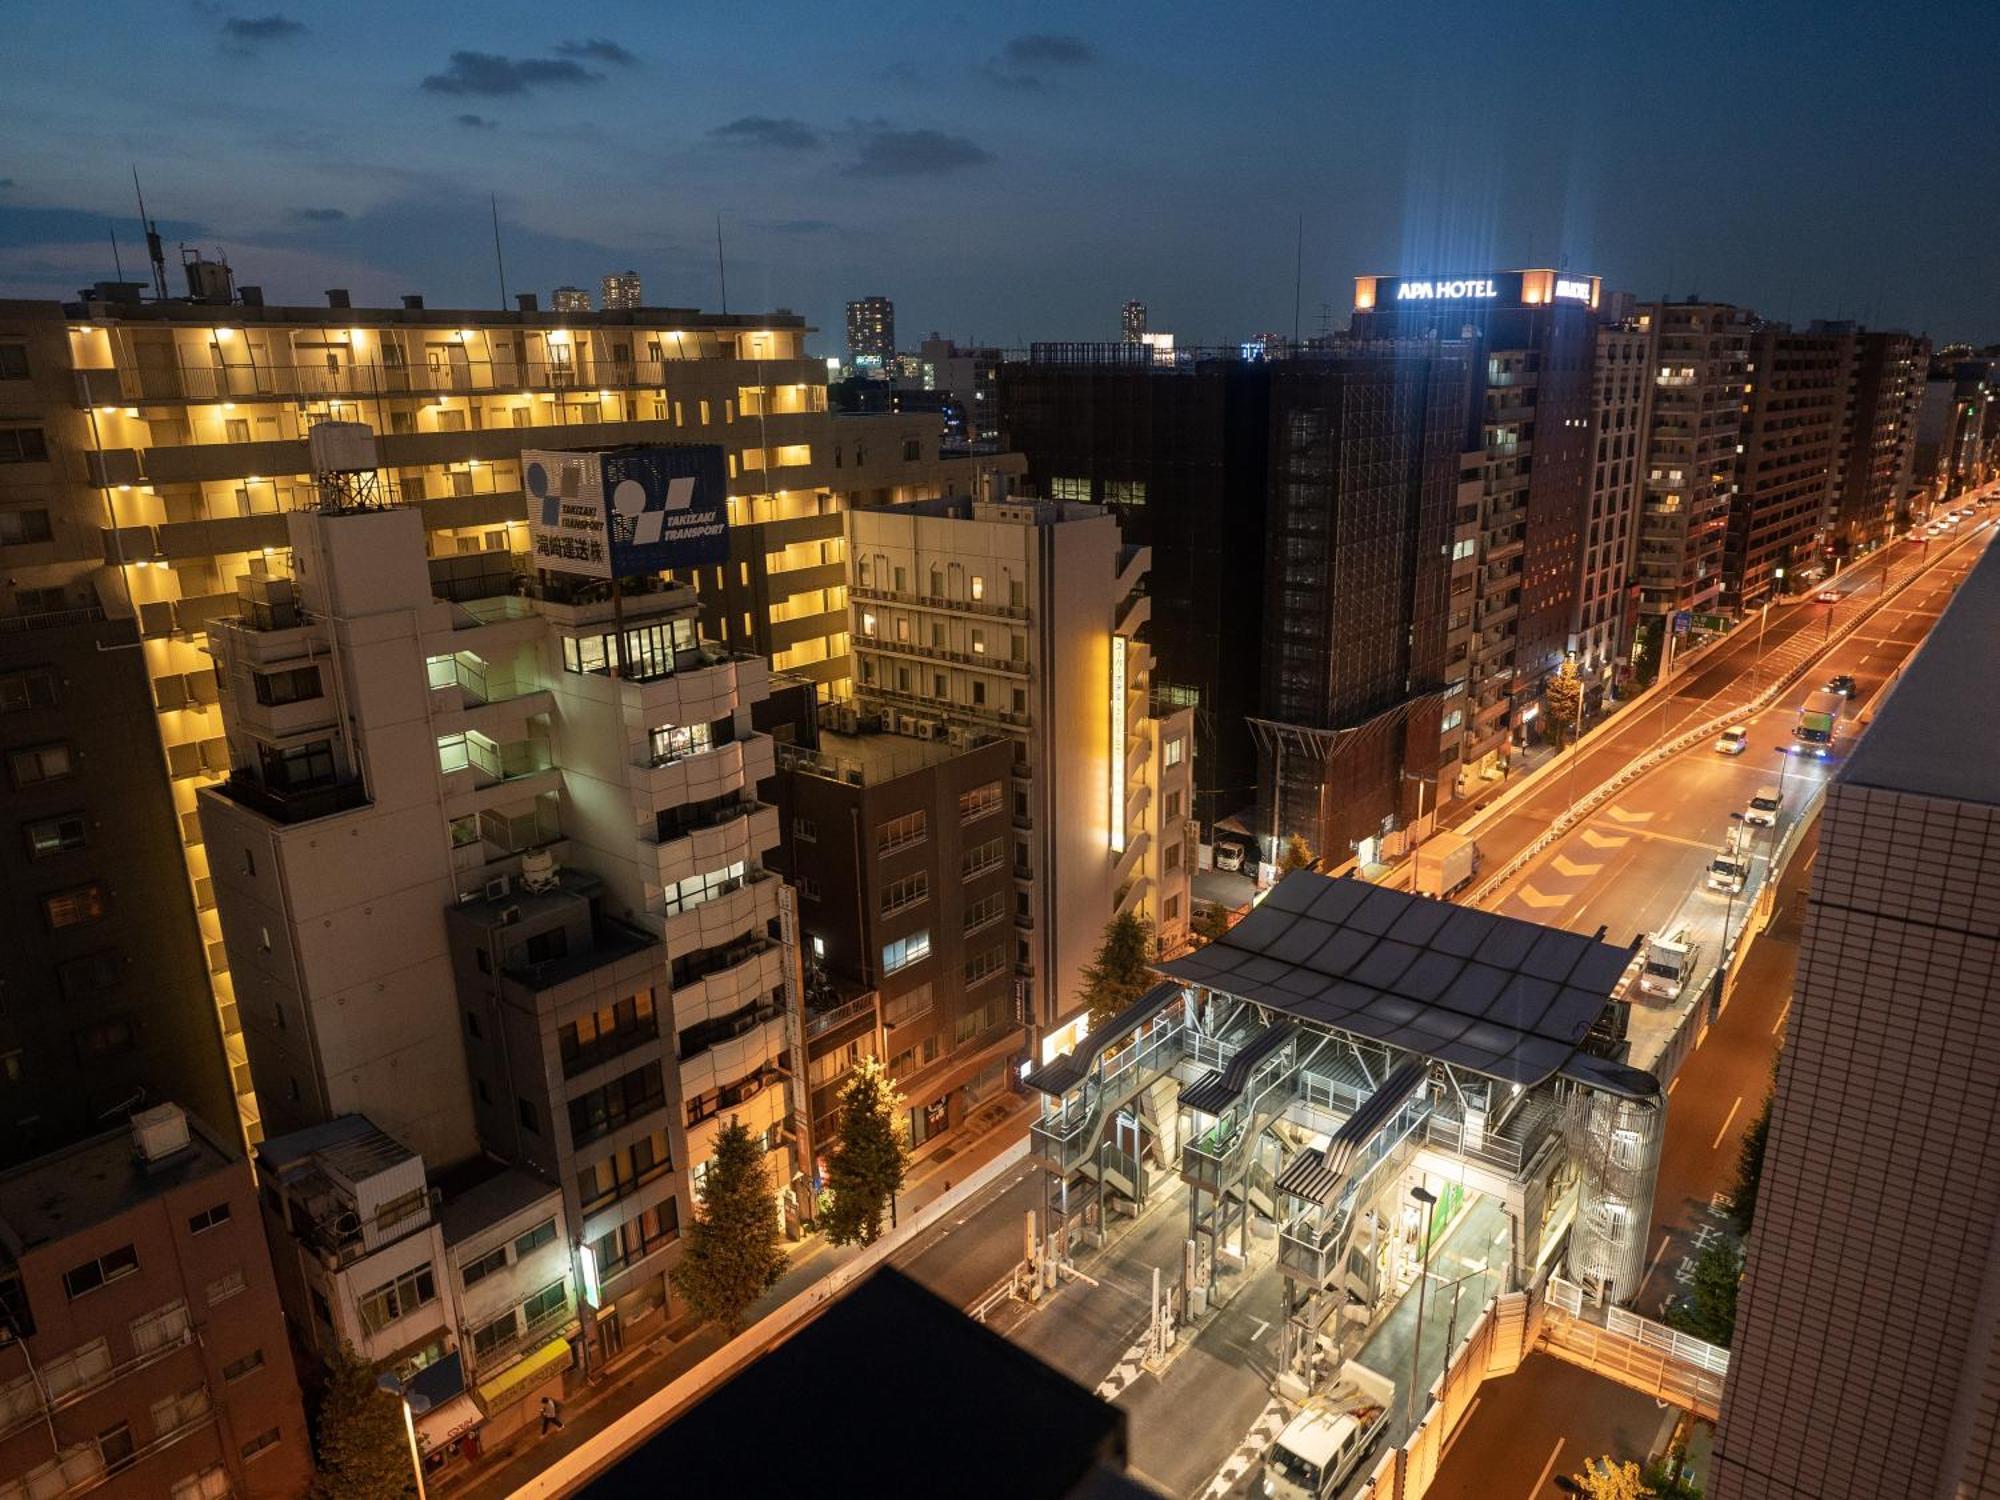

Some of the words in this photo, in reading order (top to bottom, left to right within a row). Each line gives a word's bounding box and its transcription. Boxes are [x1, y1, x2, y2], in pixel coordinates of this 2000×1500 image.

[1397, 283, 1433, 300] APA
[1436, 280, 1497, 298] HOTEL
[562, 504, 597, 516] TAKIZAKI
[562, 518, 604, 531] TRANSPORT
[667, 512, 716, 526] TAKIZAKI
[664, 523, 725, 541] TRANSPORT
